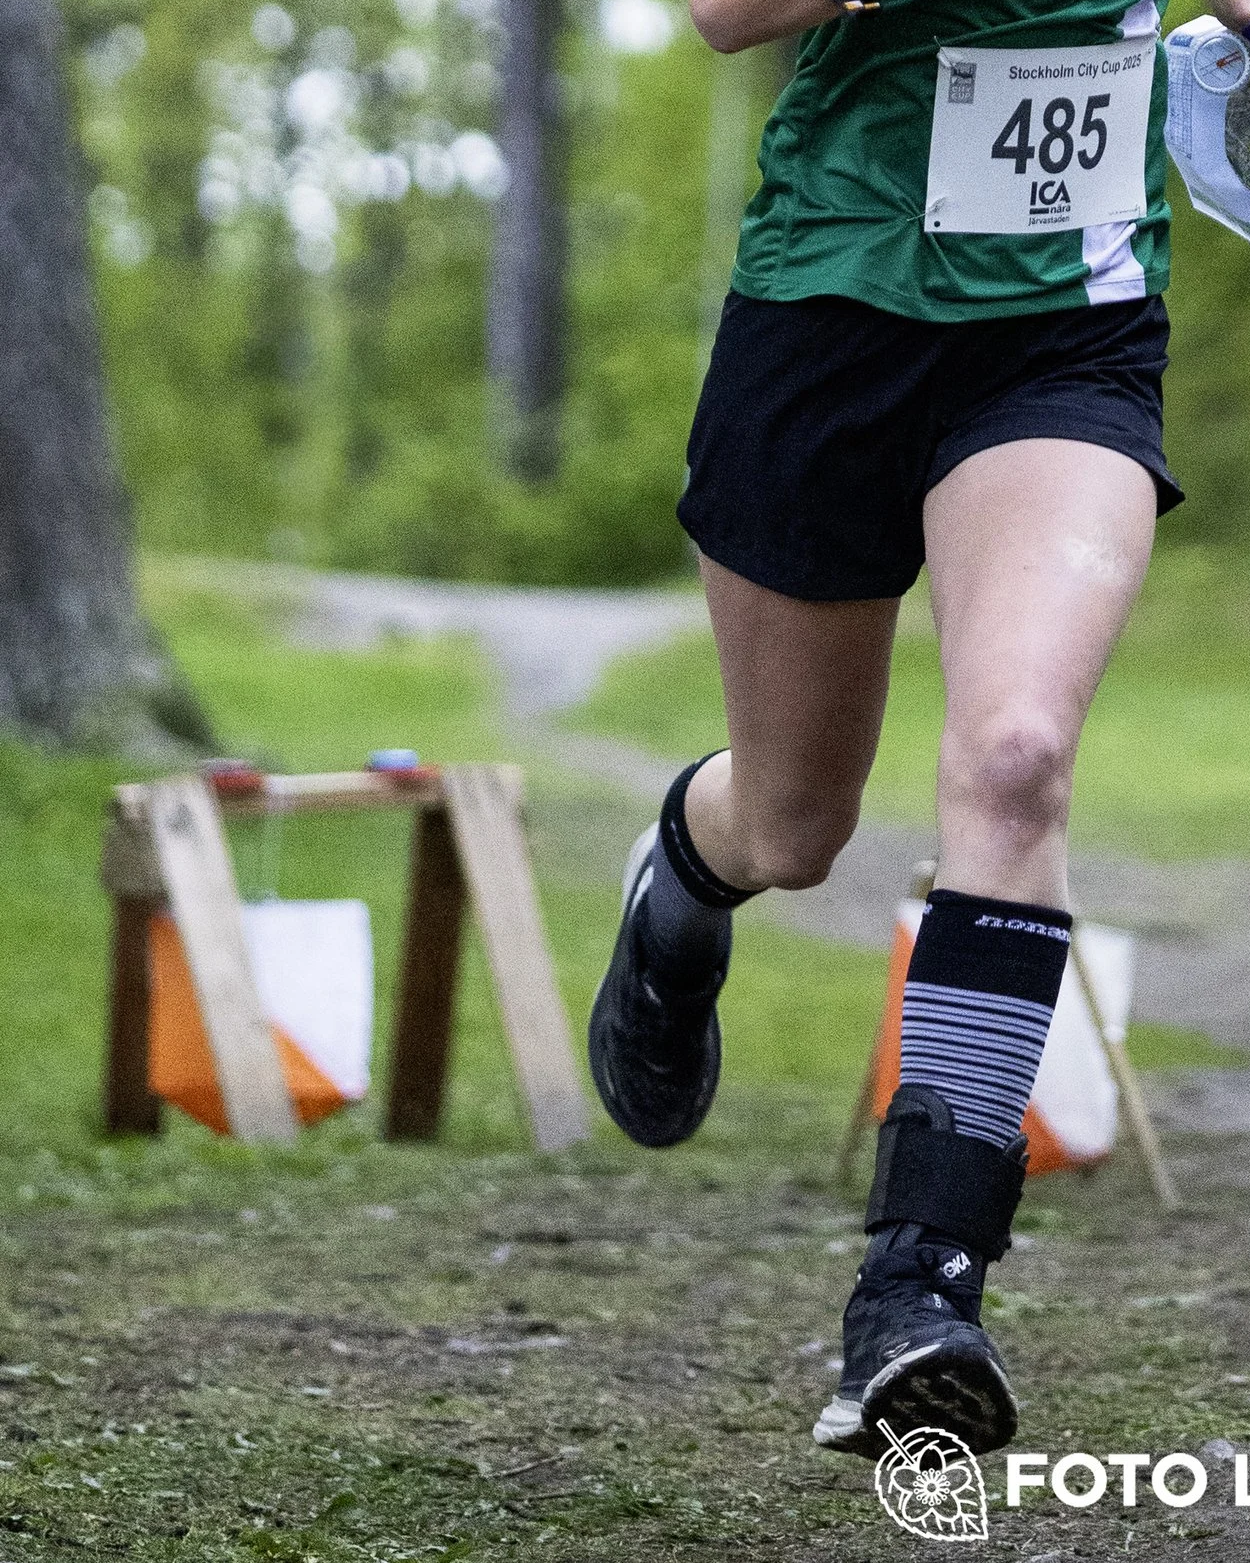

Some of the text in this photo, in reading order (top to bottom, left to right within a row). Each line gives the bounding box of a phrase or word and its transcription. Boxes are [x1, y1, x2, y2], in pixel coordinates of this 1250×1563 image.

[1009, 53, 1142, 80] Stockholm City Cup 2025
[991, 93, 1111, 174] 485
[1030, 179, 1071, 206] ICA
[940, 1251, 971, 1278] OKA
